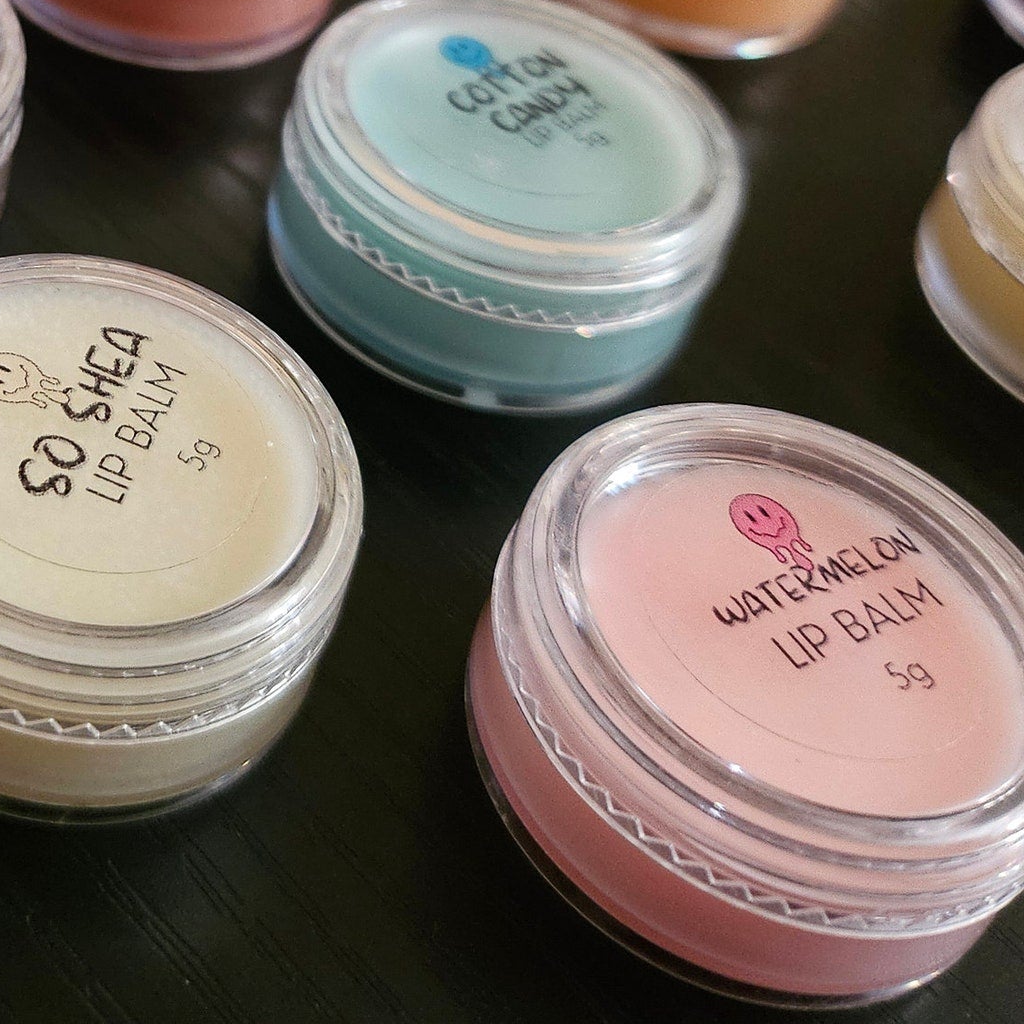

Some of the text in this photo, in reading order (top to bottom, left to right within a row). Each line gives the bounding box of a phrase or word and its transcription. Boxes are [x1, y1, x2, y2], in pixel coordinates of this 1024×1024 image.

[446, 46, 567, 114] COTTON
[489, 74, 591, 134] CANDY
[18, 326, 151, 496] SO SHEA
[85, 360, 187, 505] LIP BALM
[177, 439, 221, 471] 5g
[712, 526, 922, 627] WATERMELON
[771, 577, 945, 670] LIP BALM
[884, 661, 935, 691] 5g
